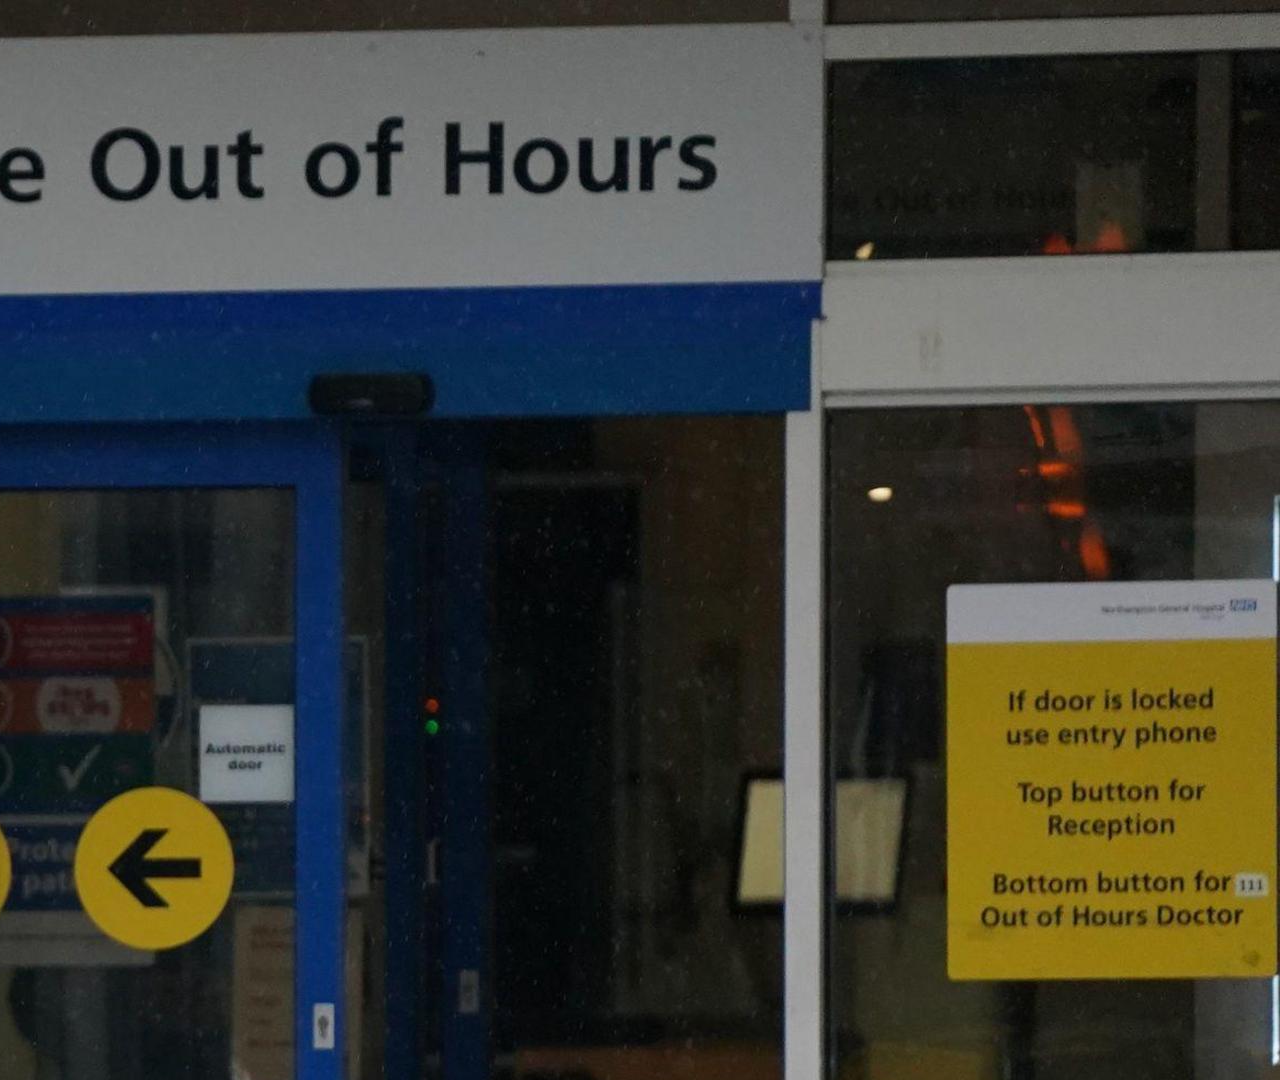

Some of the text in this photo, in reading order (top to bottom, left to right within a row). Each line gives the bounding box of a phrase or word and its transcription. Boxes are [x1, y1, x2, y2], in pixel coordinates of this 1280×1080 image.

[90, 127, 264, 201] Out
[304, 117, 404, 198] of
[444, 121, 718, 194] Hours
[1008, 687, 1215, 712] If door is locked
[1006, 720, 1217, 749] use entry phone
[206, 743, 287, 755] Automatic
[228, 760, 263, 771] door
[1017, 778, 1206, 807] Top button for
[1047, 812, 1175, 840] Reception
[992, 869, 1232, 895] Bottom button for
[980, 904, 1245, 928] Out of Hours Doctor
